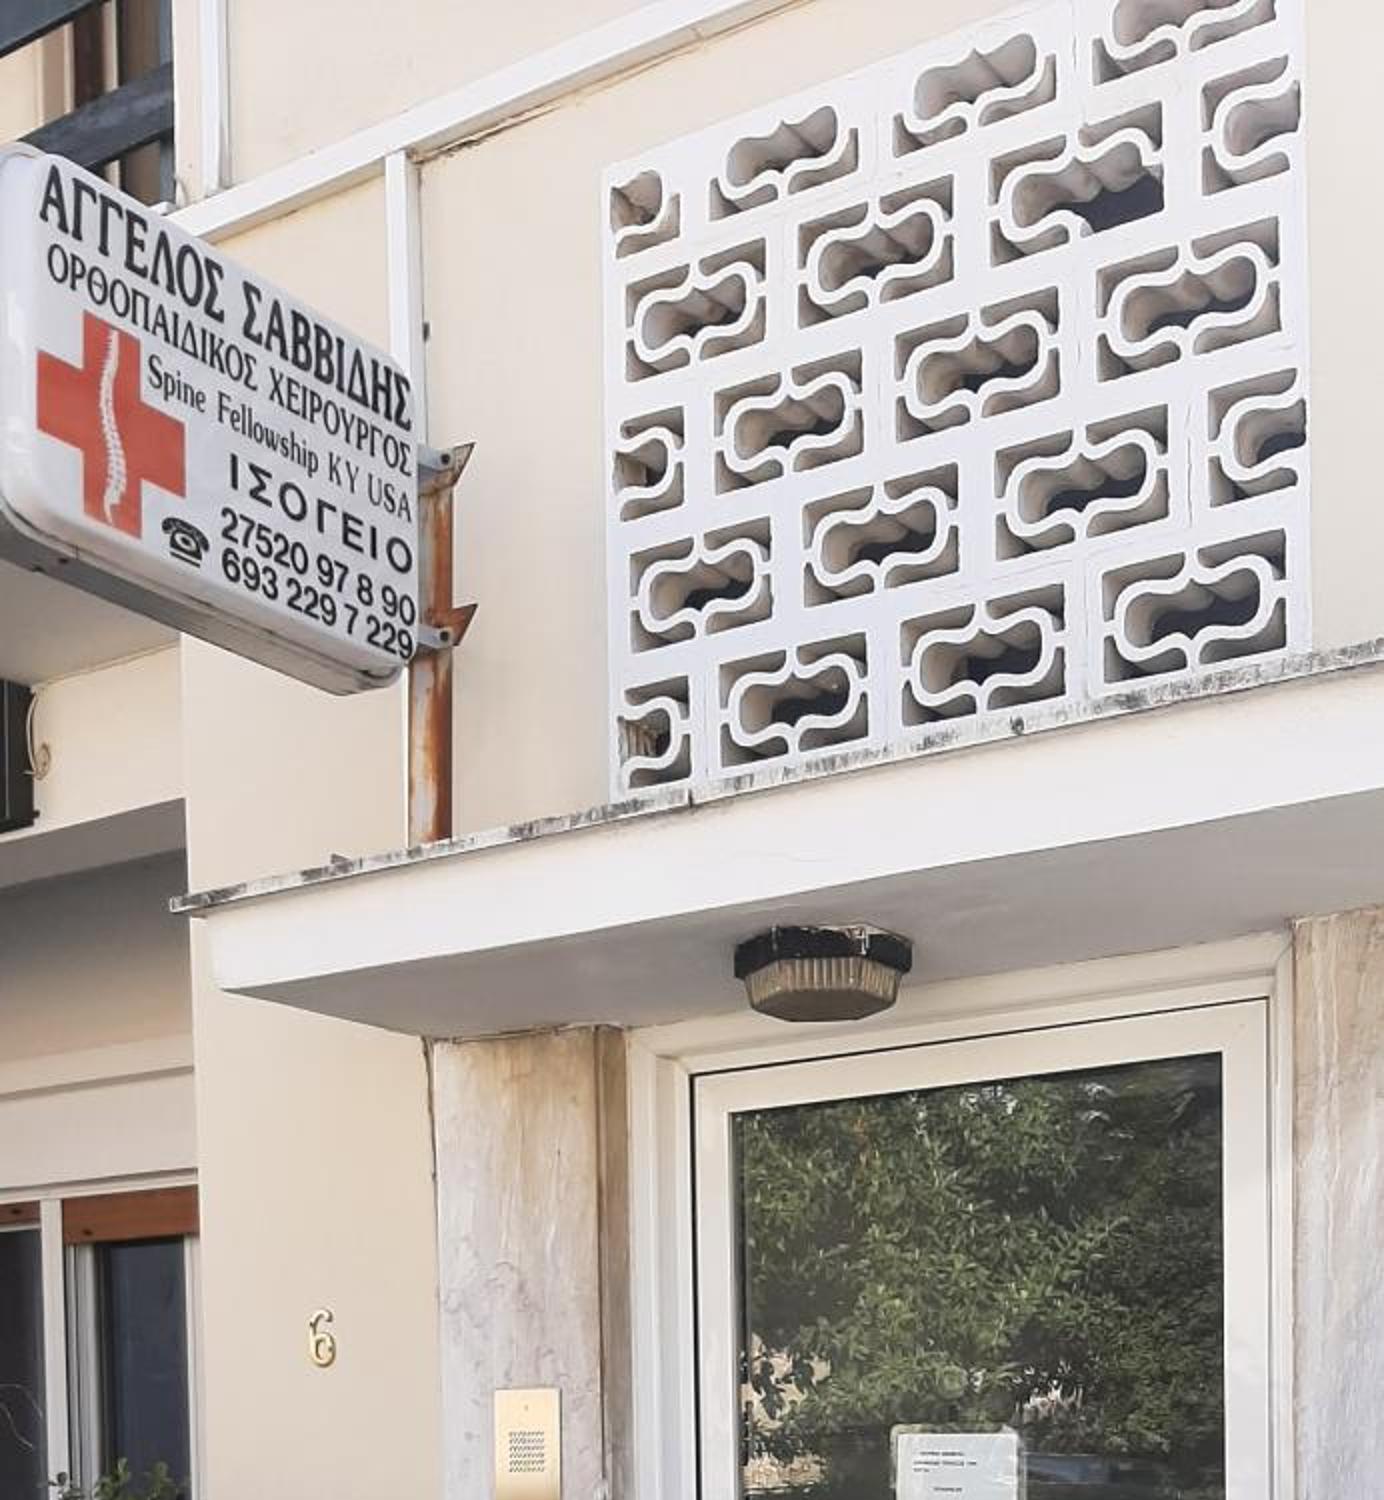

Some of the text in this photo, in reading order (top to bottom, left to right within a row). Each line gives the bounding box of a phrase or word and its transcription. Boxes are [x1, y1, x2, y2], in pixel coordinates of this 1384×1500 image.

[39, 165, 412, 430] ΑΓΓΕΛΟΣ ΣΑΒΒΙΔΗΣ
[48, 244, 412, 476] ΟΡΘΟΠΑΙΔΙΚΟΣ ΧΕΙΡΟΥΡΓΟΣ
[148, 356, 412, 522] Spine Fellowship KY USA
[221, 508, 415, 626] 27520 97 8 90
[230, 454, 413, 574] ΙΣΟΓΕΙΟ
[222, 551, 413, 659] 693 229 7 229
[309, 1308, 336, 1368] 6
